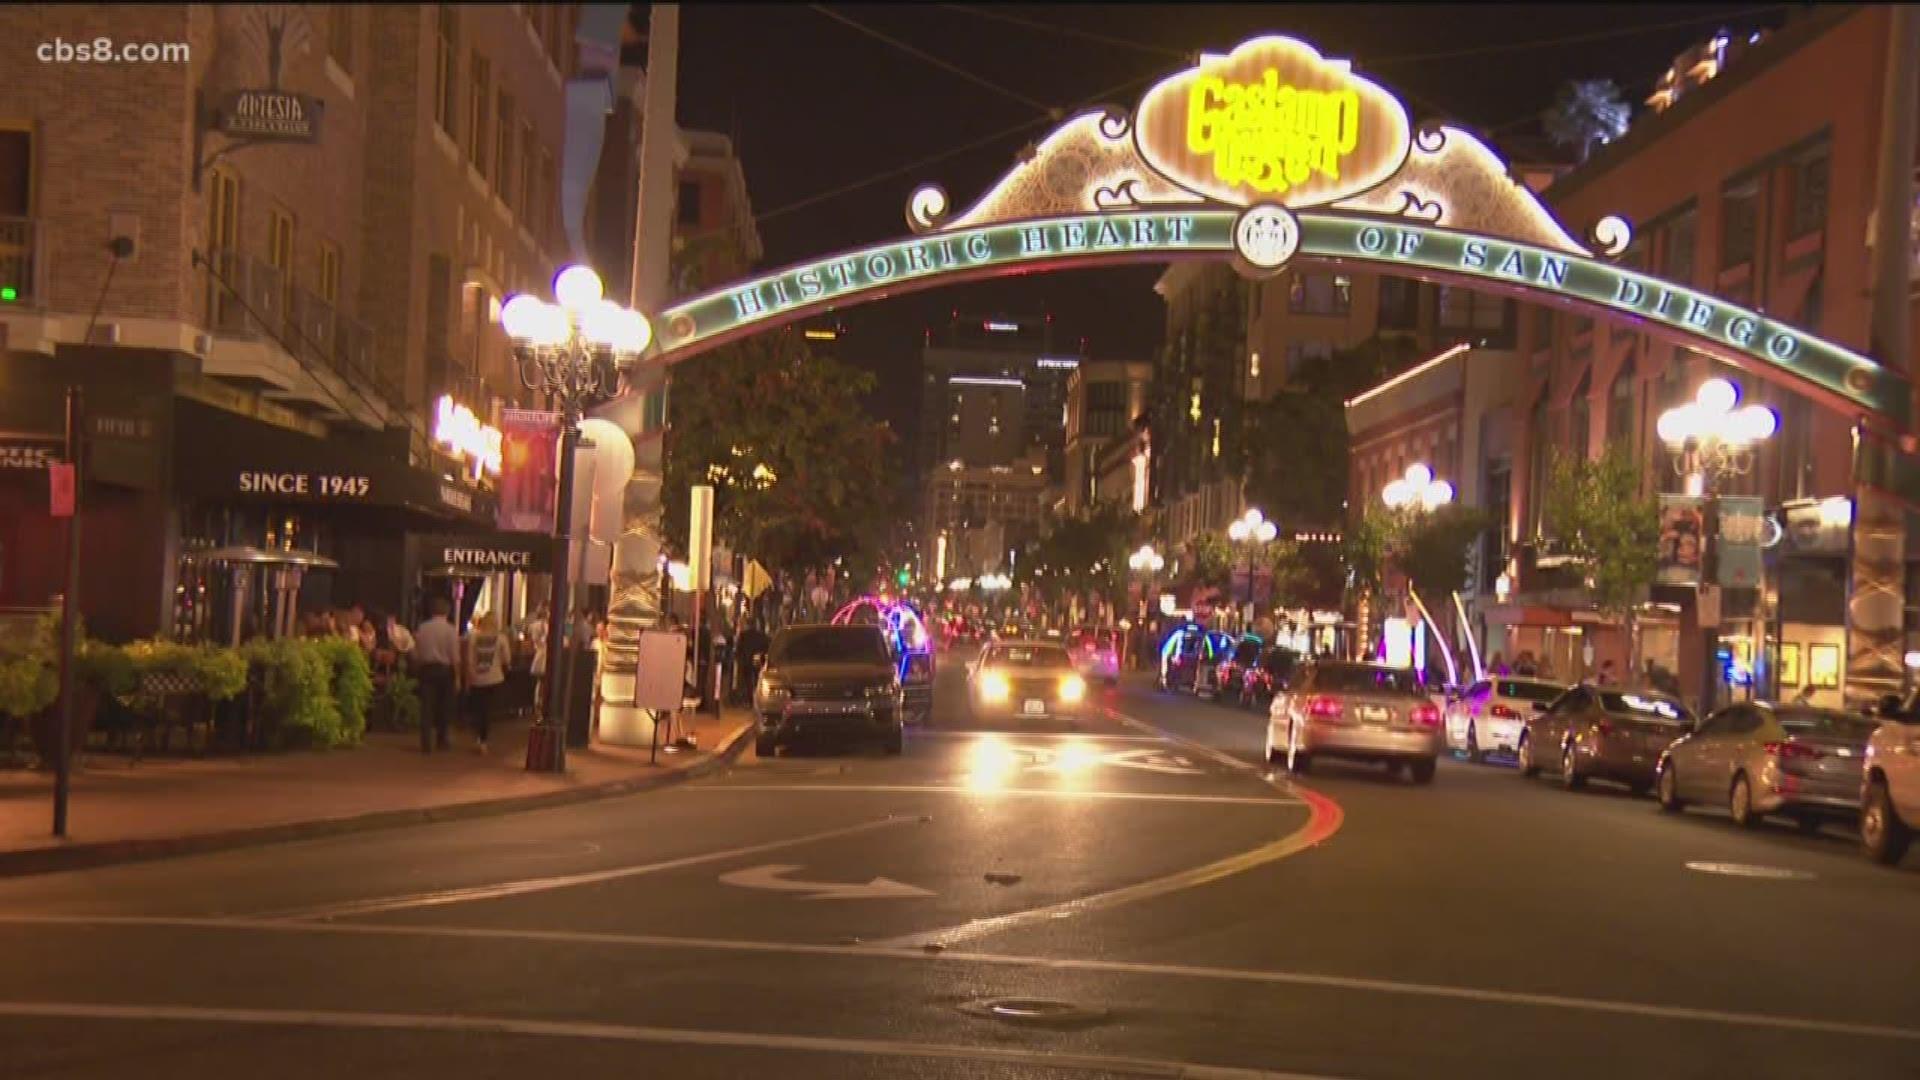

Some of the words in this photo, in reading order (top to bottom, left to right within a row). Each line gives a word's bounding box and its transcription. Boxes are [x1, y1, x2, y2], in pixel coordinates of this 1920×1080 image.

[734, 231, 992, 318] HISTORIC
[1021, 214, 1191, 253] HEART
[1356, 226, 1423, 256] OF
[1463, 239, 1569, 287] SAN
[1615, 276, 1801, 361] DIEGO
[239, 471, 309, 494] SINCE
[318, 475, 370, 497] 1945
[443, 547, 532, 566] ENTRANCE
